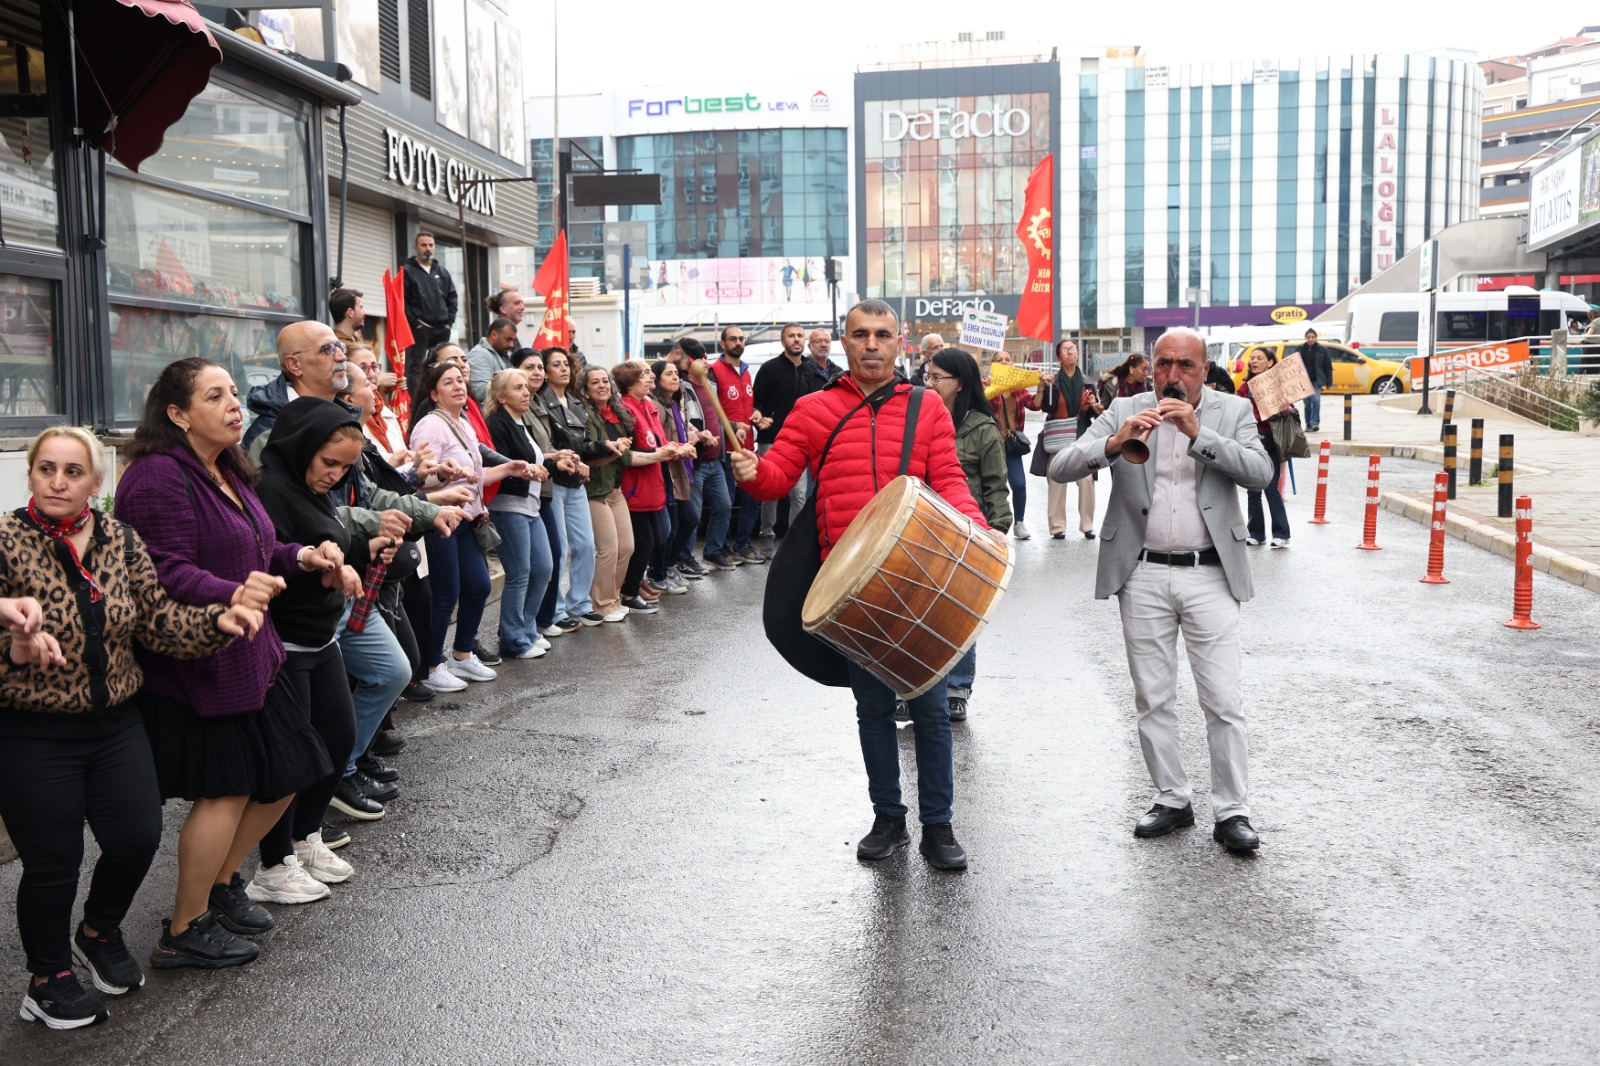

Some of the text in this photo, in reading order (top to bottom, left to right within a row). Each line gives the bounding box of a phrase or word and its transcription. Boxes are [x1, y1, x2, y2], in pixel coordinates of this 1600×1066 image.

[628, 93, 799, 118] Forbest LEVA
[882, 103, 1030, 142] DeFacto
[383, 127, 440, 195] FOTO
[1377, 108, 1396, 270] LALOĞLU
[968, 323, 980, 333] EMEK
[1275, 309, 1304, 319] gratis
